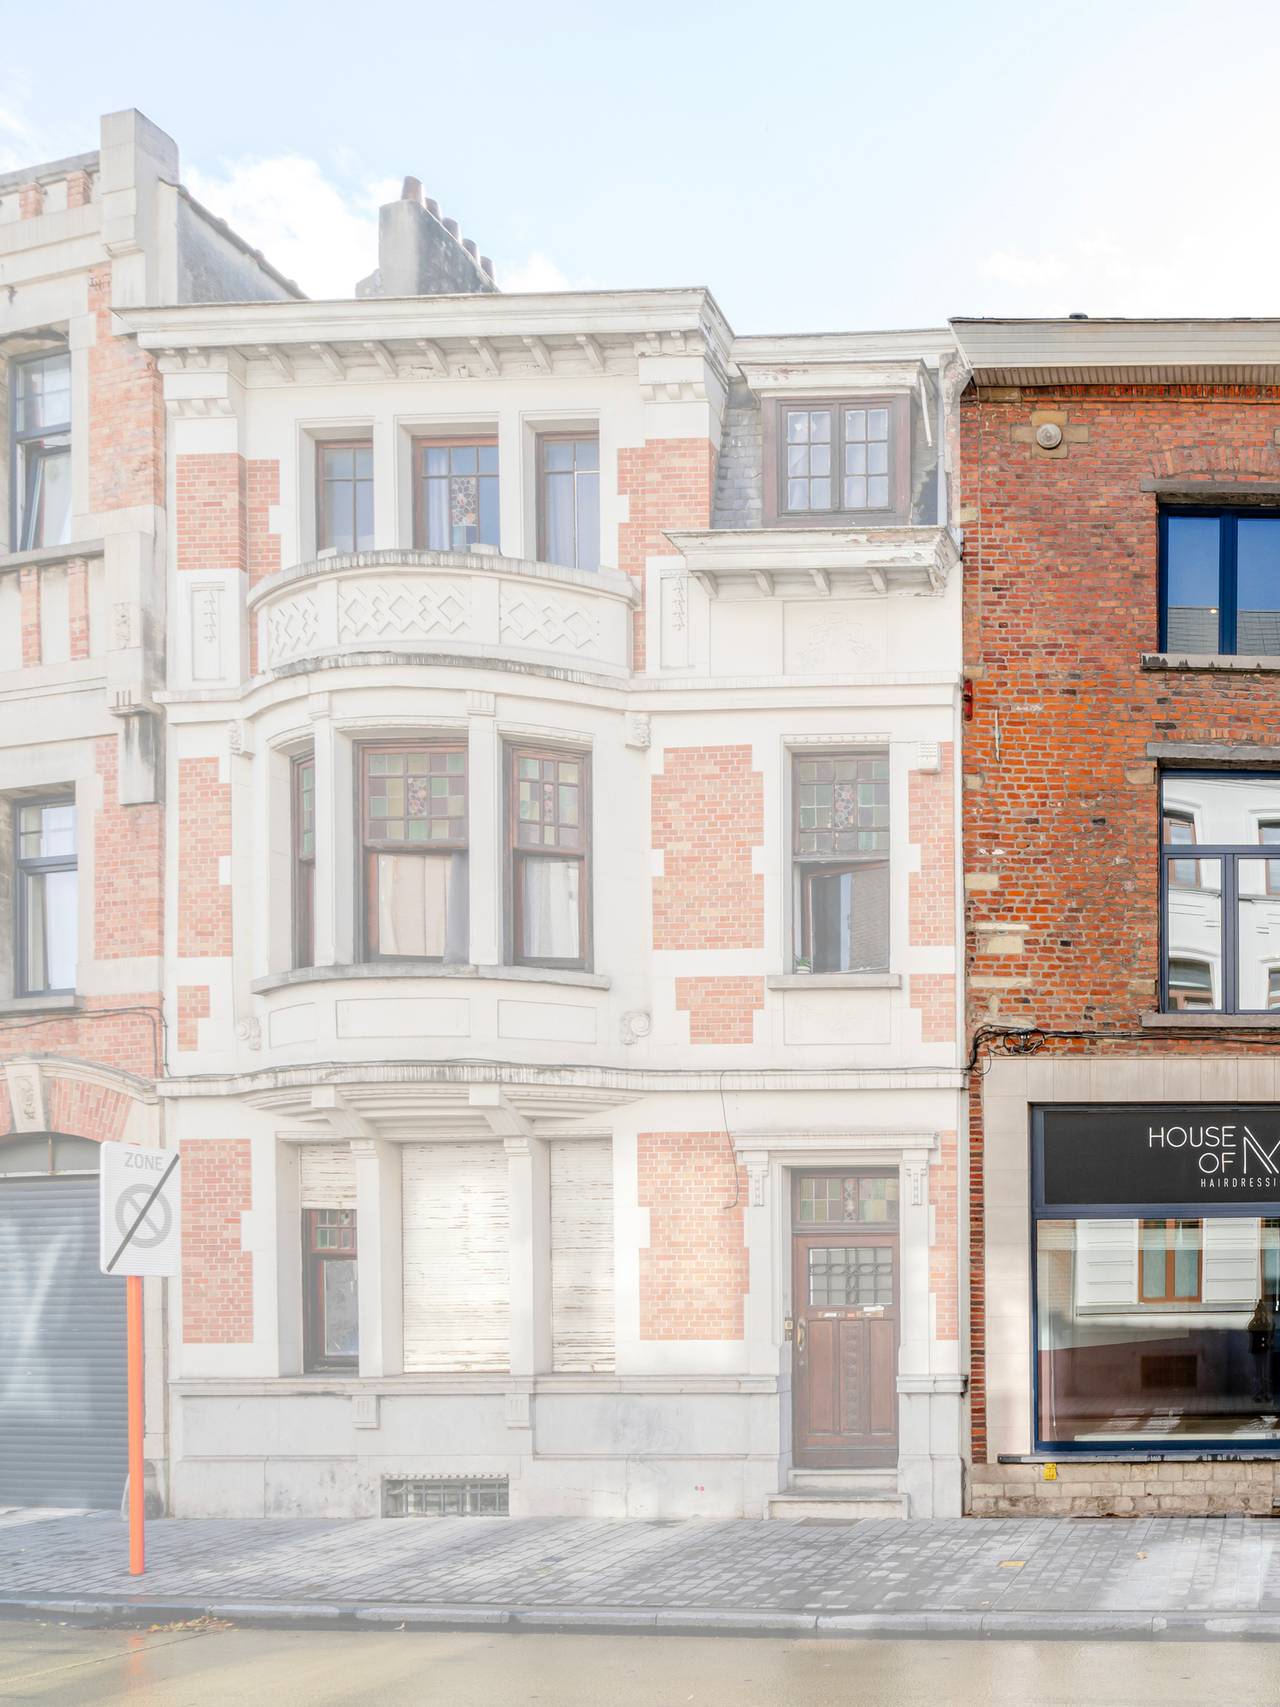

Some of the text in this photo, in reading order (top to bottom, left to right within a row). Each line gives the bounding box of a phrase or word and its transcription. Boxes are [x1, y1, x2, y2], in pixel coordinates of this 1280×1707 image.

[1149, 1126, 1236, 1147] HOUSE
[124, 1152, 164, 1171] ZONE
[1199, 1152, 1236, 1173] OF
